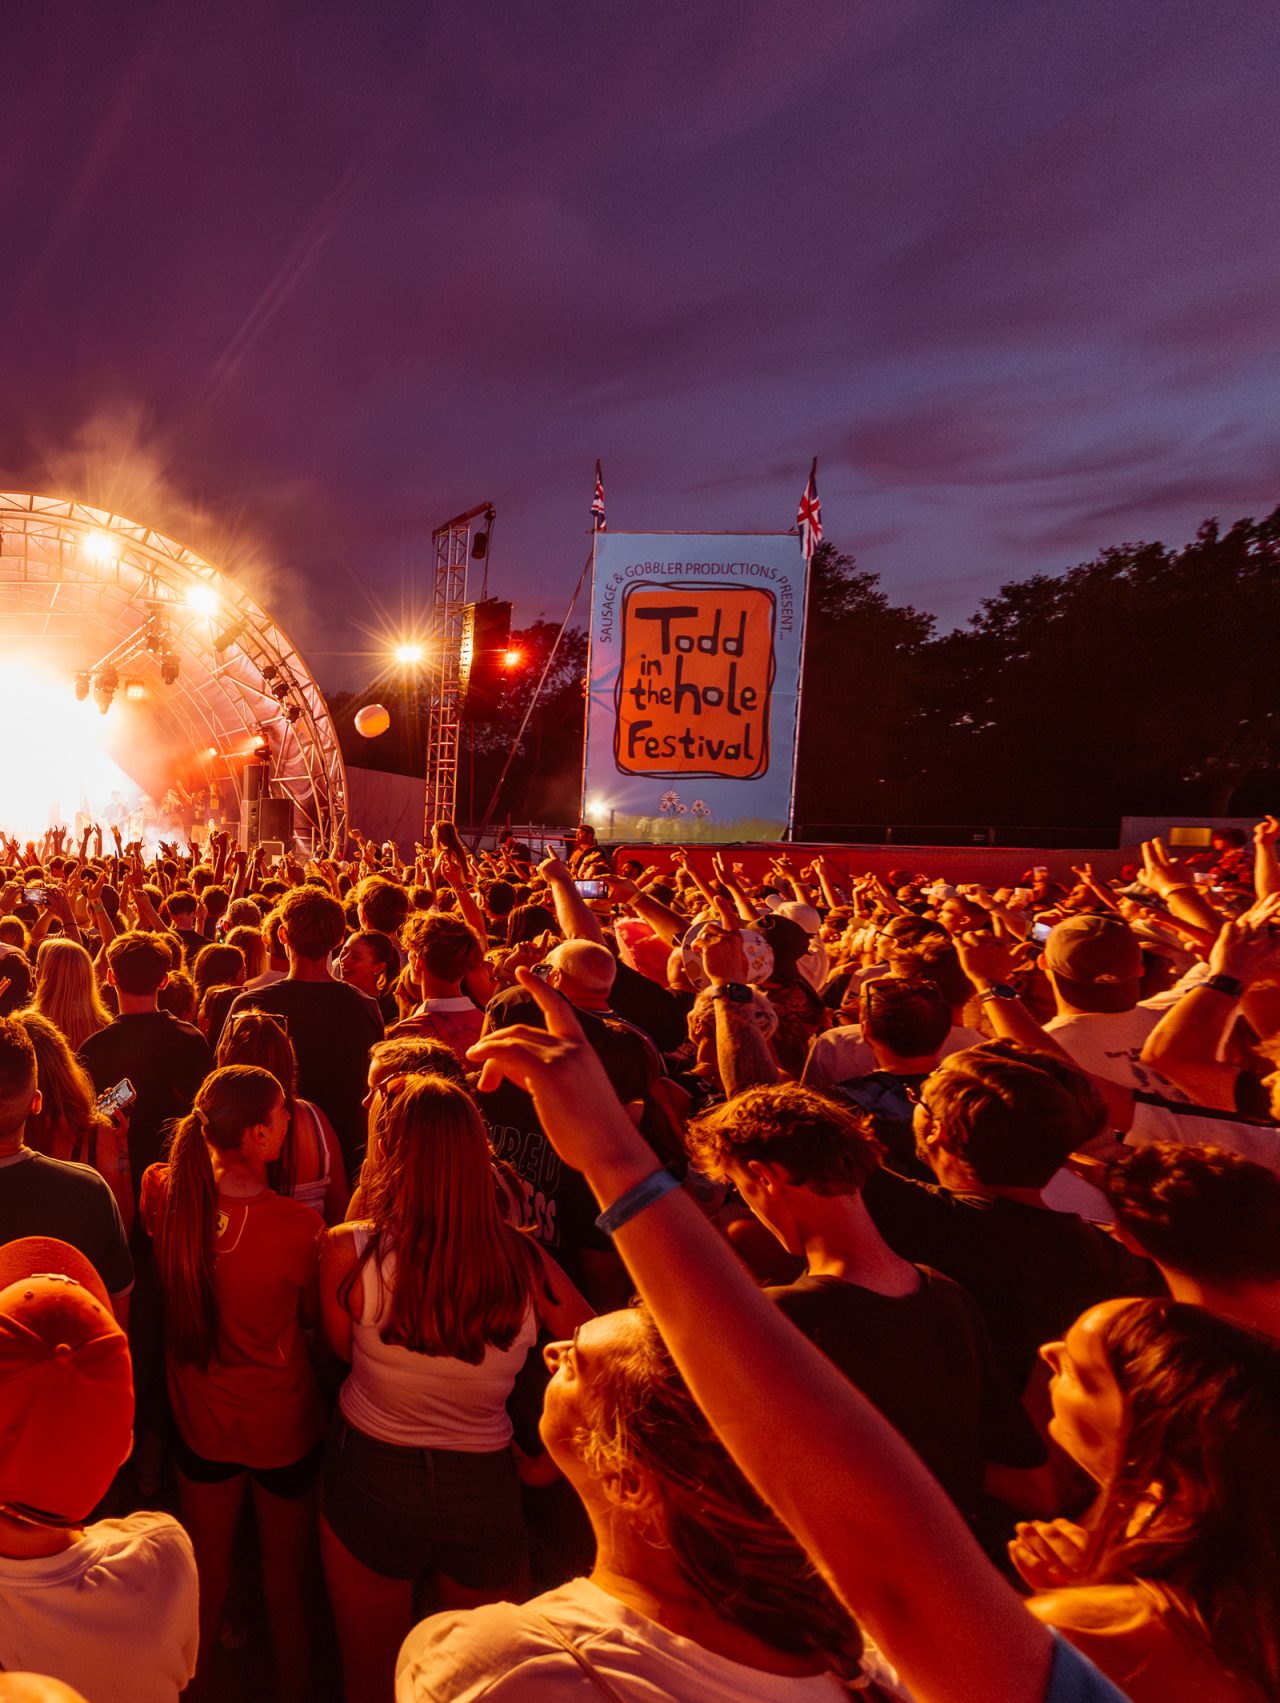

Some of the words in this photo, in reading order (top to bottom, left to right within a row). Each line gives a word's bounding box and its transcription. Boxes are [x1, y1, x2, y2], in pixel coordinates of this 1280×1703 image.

[599, 584, 618, 643] SAUSAGE
[613, 573, 625, 584] &
[625, 562, 682, 578] GOBBLER
[686, 563, 778, 580] PRODUCTIONS
[777, 575, 792, 640] PRESENT...
[635, 606, 747, 657] Todd
[630, 679, 672, 710] the
[674, 655, 757, 715] hole
[641, 654, 662, 675] in
[628, 720, 754, 760] Festival
